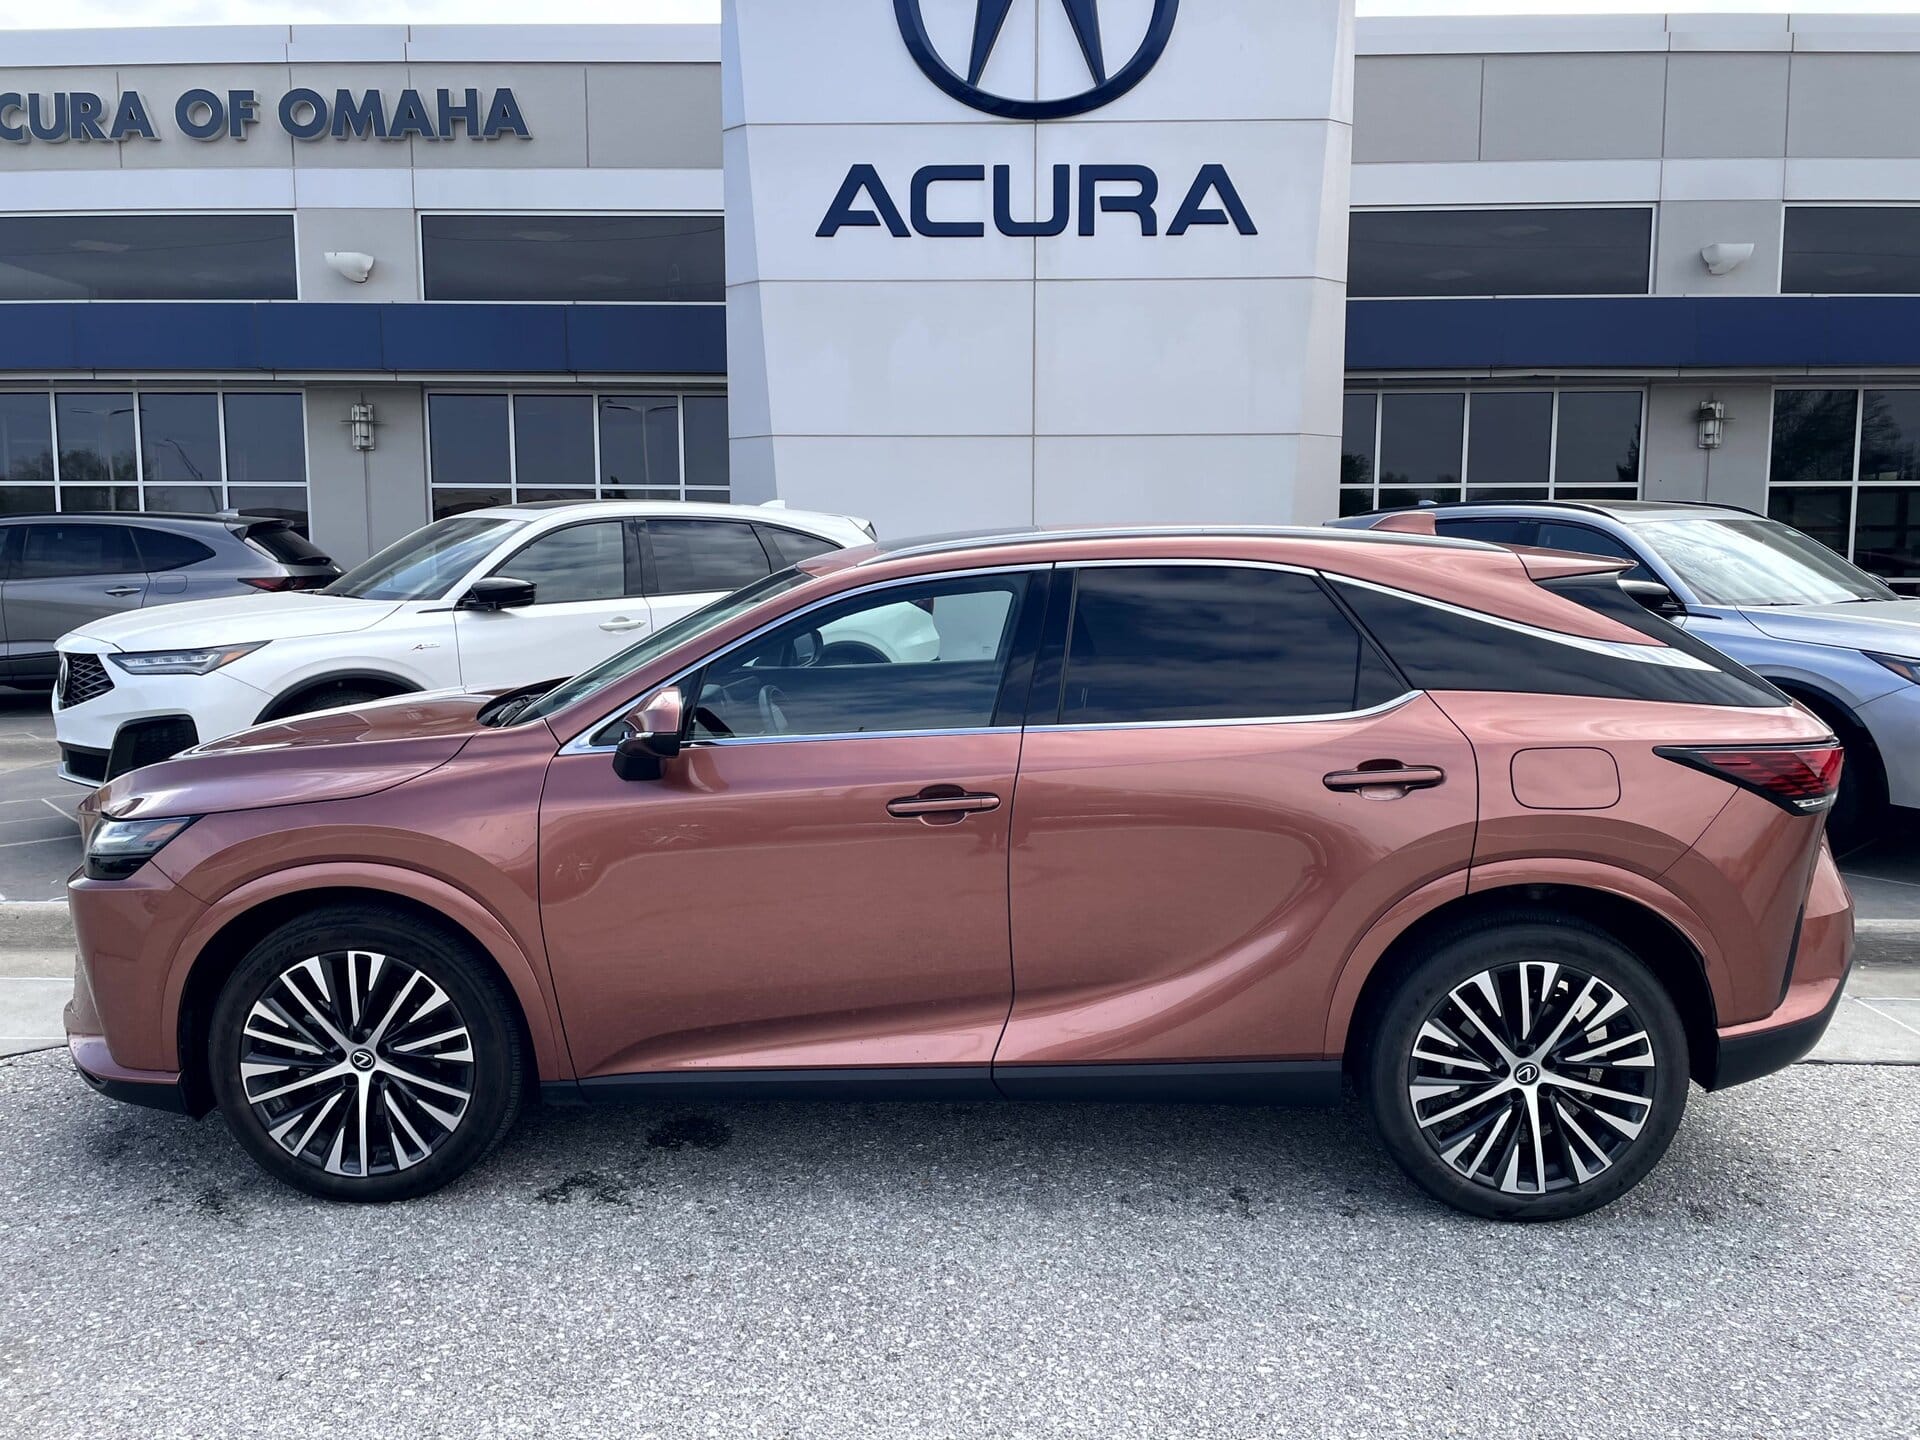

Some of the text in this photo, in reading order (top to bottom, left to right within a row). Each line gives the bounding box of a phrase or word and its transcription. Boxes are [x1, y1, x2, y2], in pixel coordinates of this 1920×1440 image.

[174, 88, 257, 139] OF
[277, 86, 531, 139] OMAHA
[815, 163, 1258, 238] ACURA
